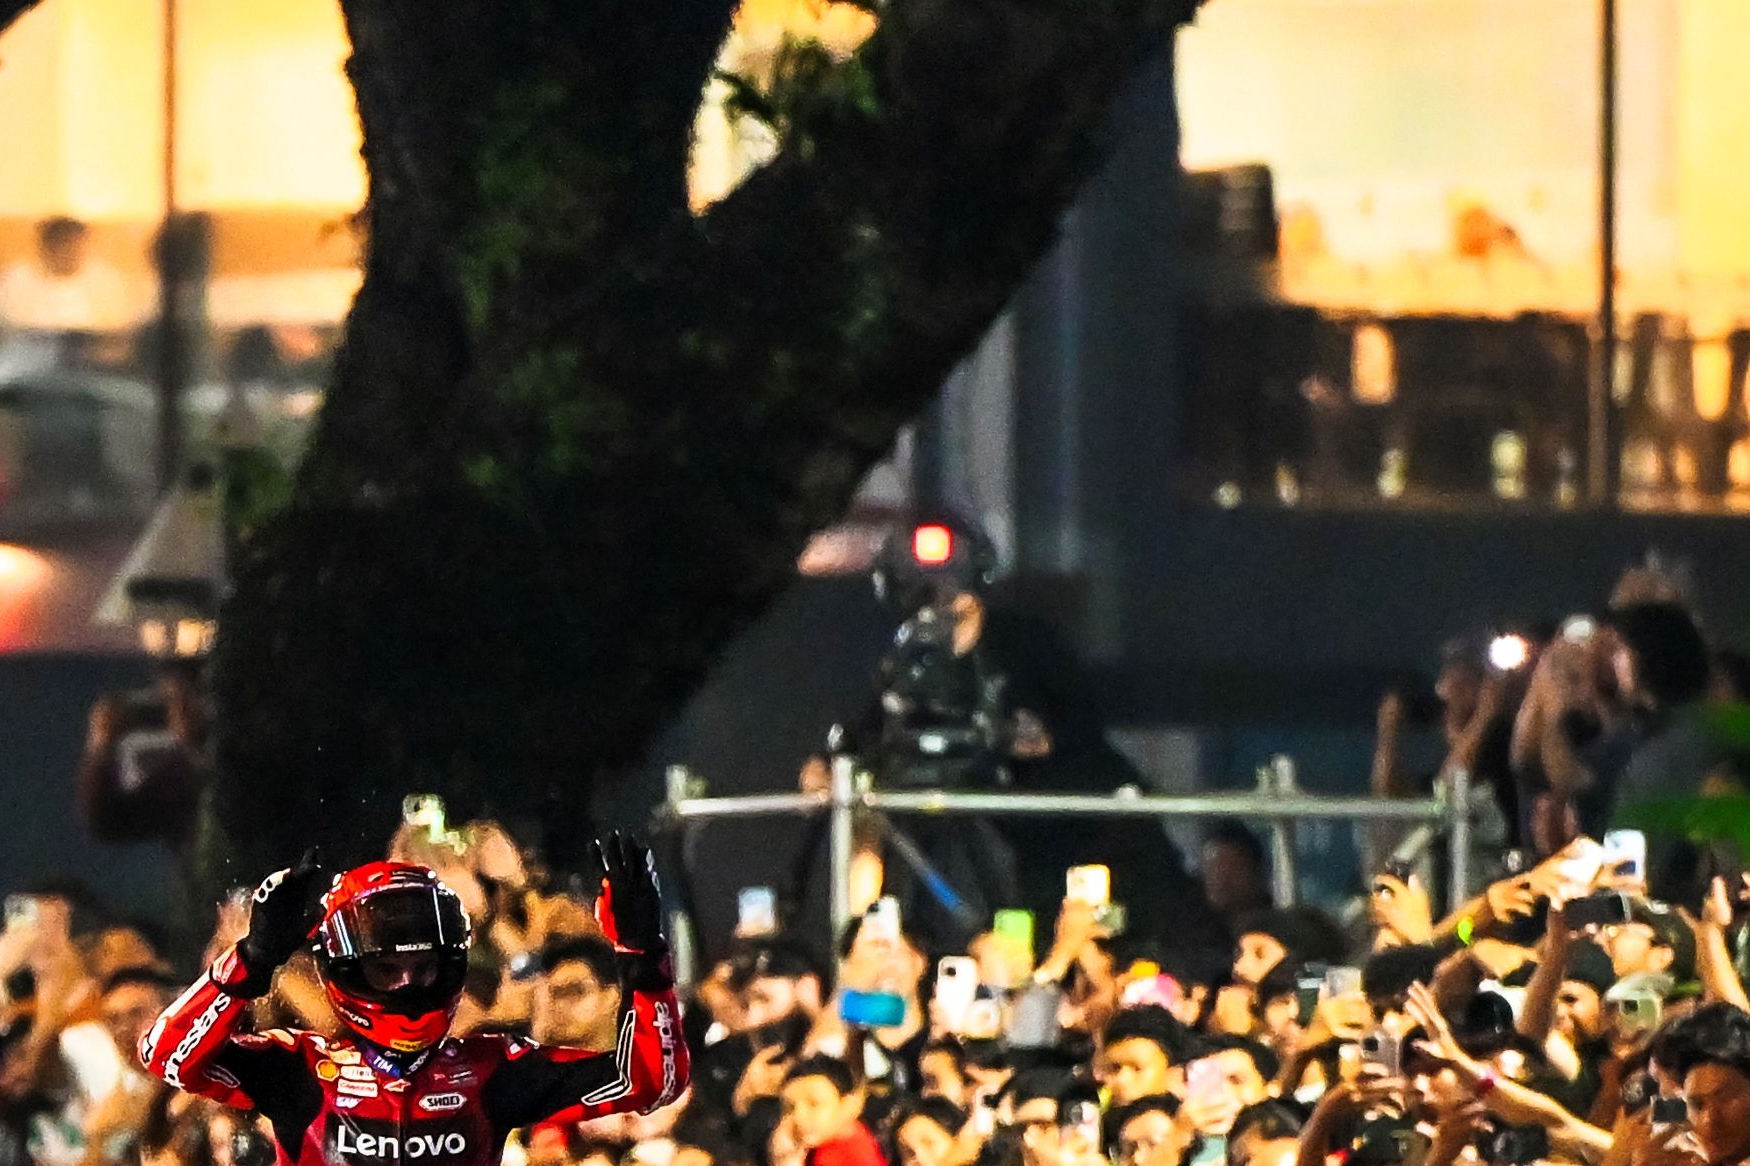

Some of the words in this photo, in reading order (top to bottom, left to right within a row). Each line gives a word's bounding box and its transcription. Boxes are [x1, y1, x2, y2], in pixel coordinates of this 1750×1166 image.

[163, 992, 231, 1088] pinestars
[374, 1055, 394, 1073] TIM
[337, 1125, 467, 1159] Lenovo
